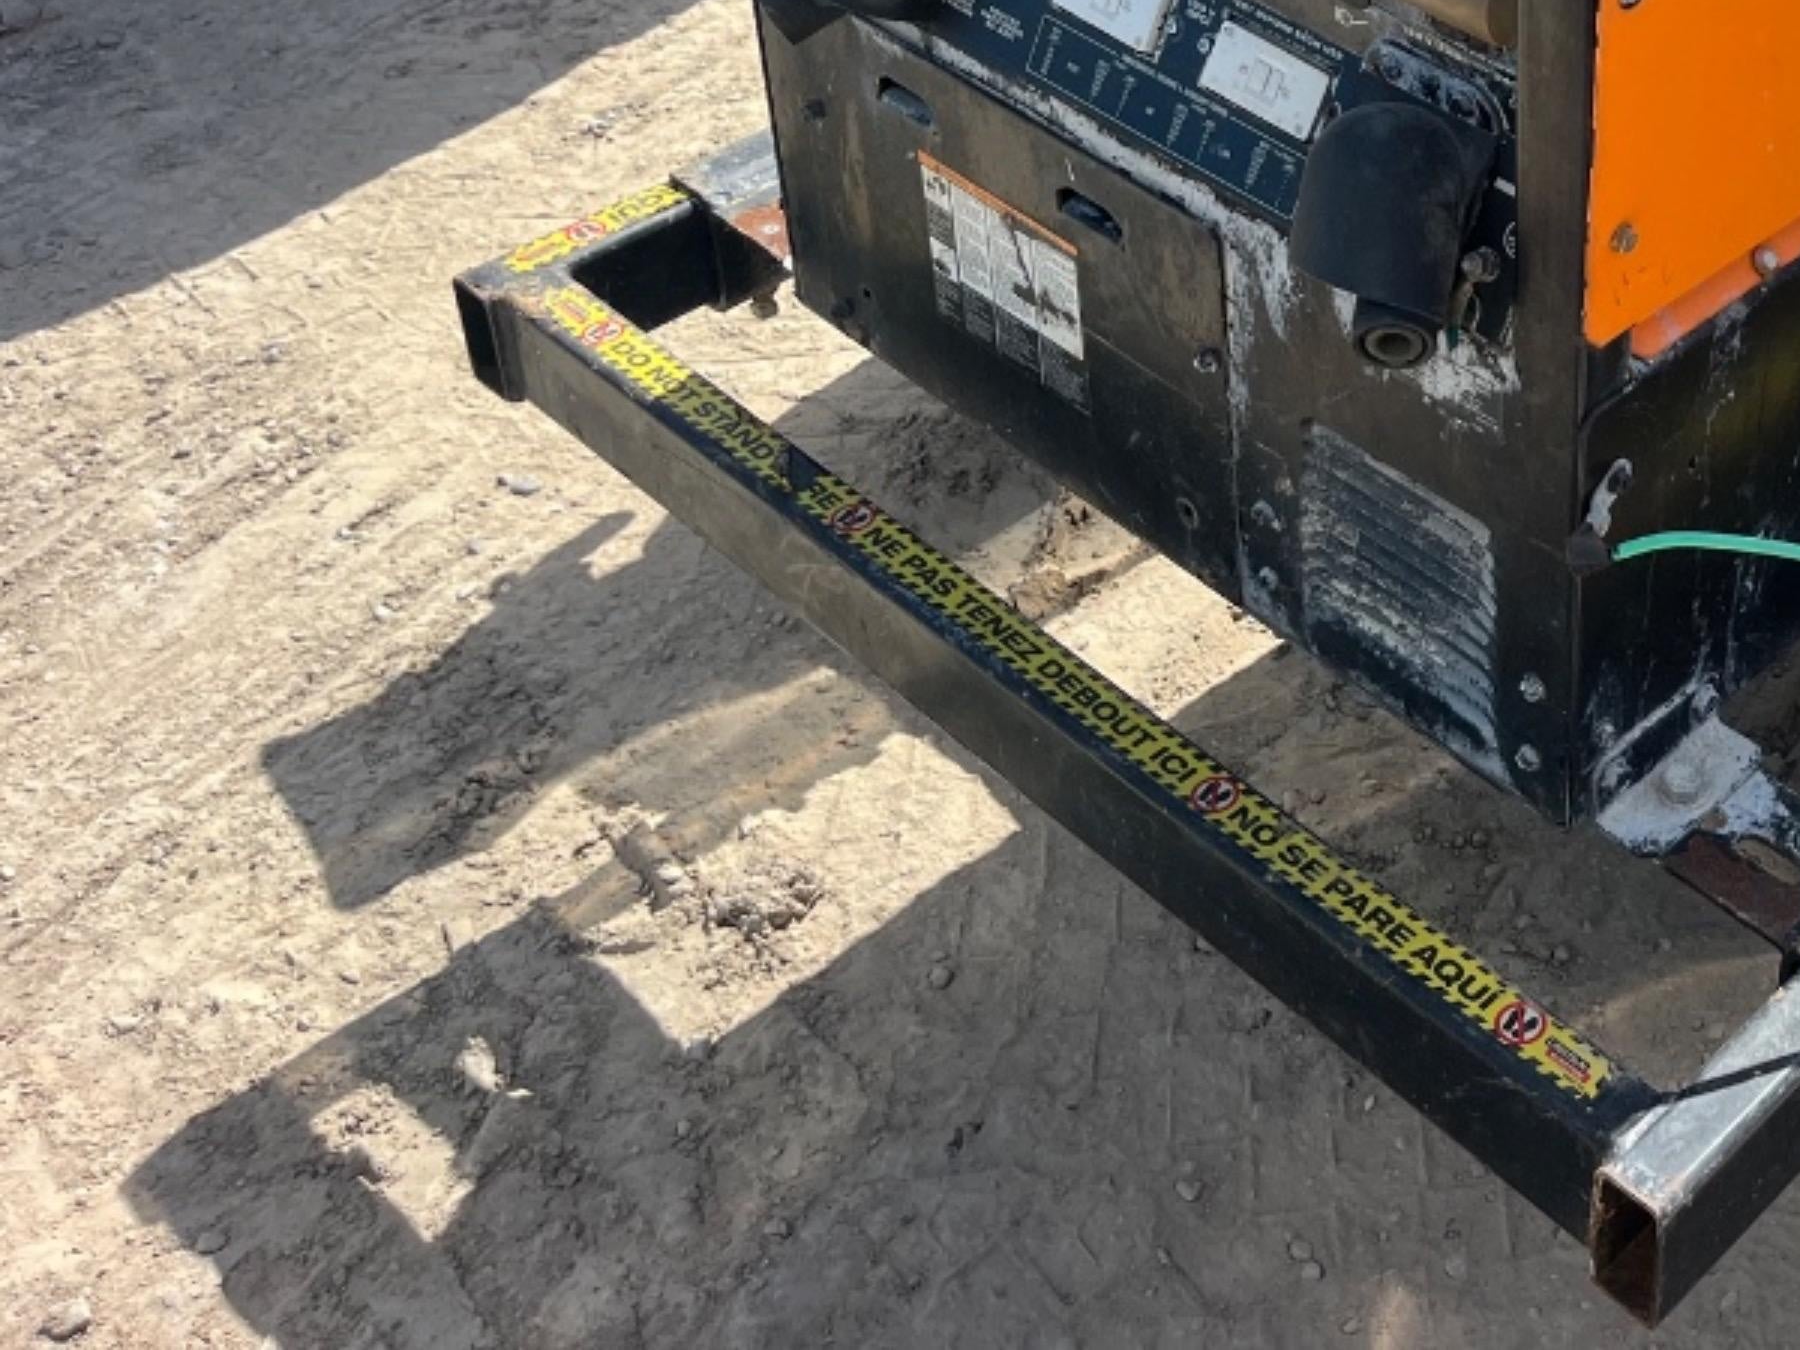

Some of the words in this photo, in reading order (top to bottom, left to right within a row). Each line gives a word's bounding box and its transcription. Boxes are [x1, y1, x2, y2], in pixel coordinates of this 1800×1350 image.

[609, 340, 652, 370] DO
[651, 363, 700, 404] NOT
[690, 398, 777, 462] STAND
[863, 526, 909, 559] NE
[898, 552, 958, 598] PAS
[955, 591, 1046, 664] TENEZ
[1037, 659, 1160, 749] DEBOUT
[1148, 745, 1198, 784] ICI
[1226, 804, 1281, 847] NO
[1276, 843, 1331, 883] SE
[1321, 875, 1418, 949] PARE
